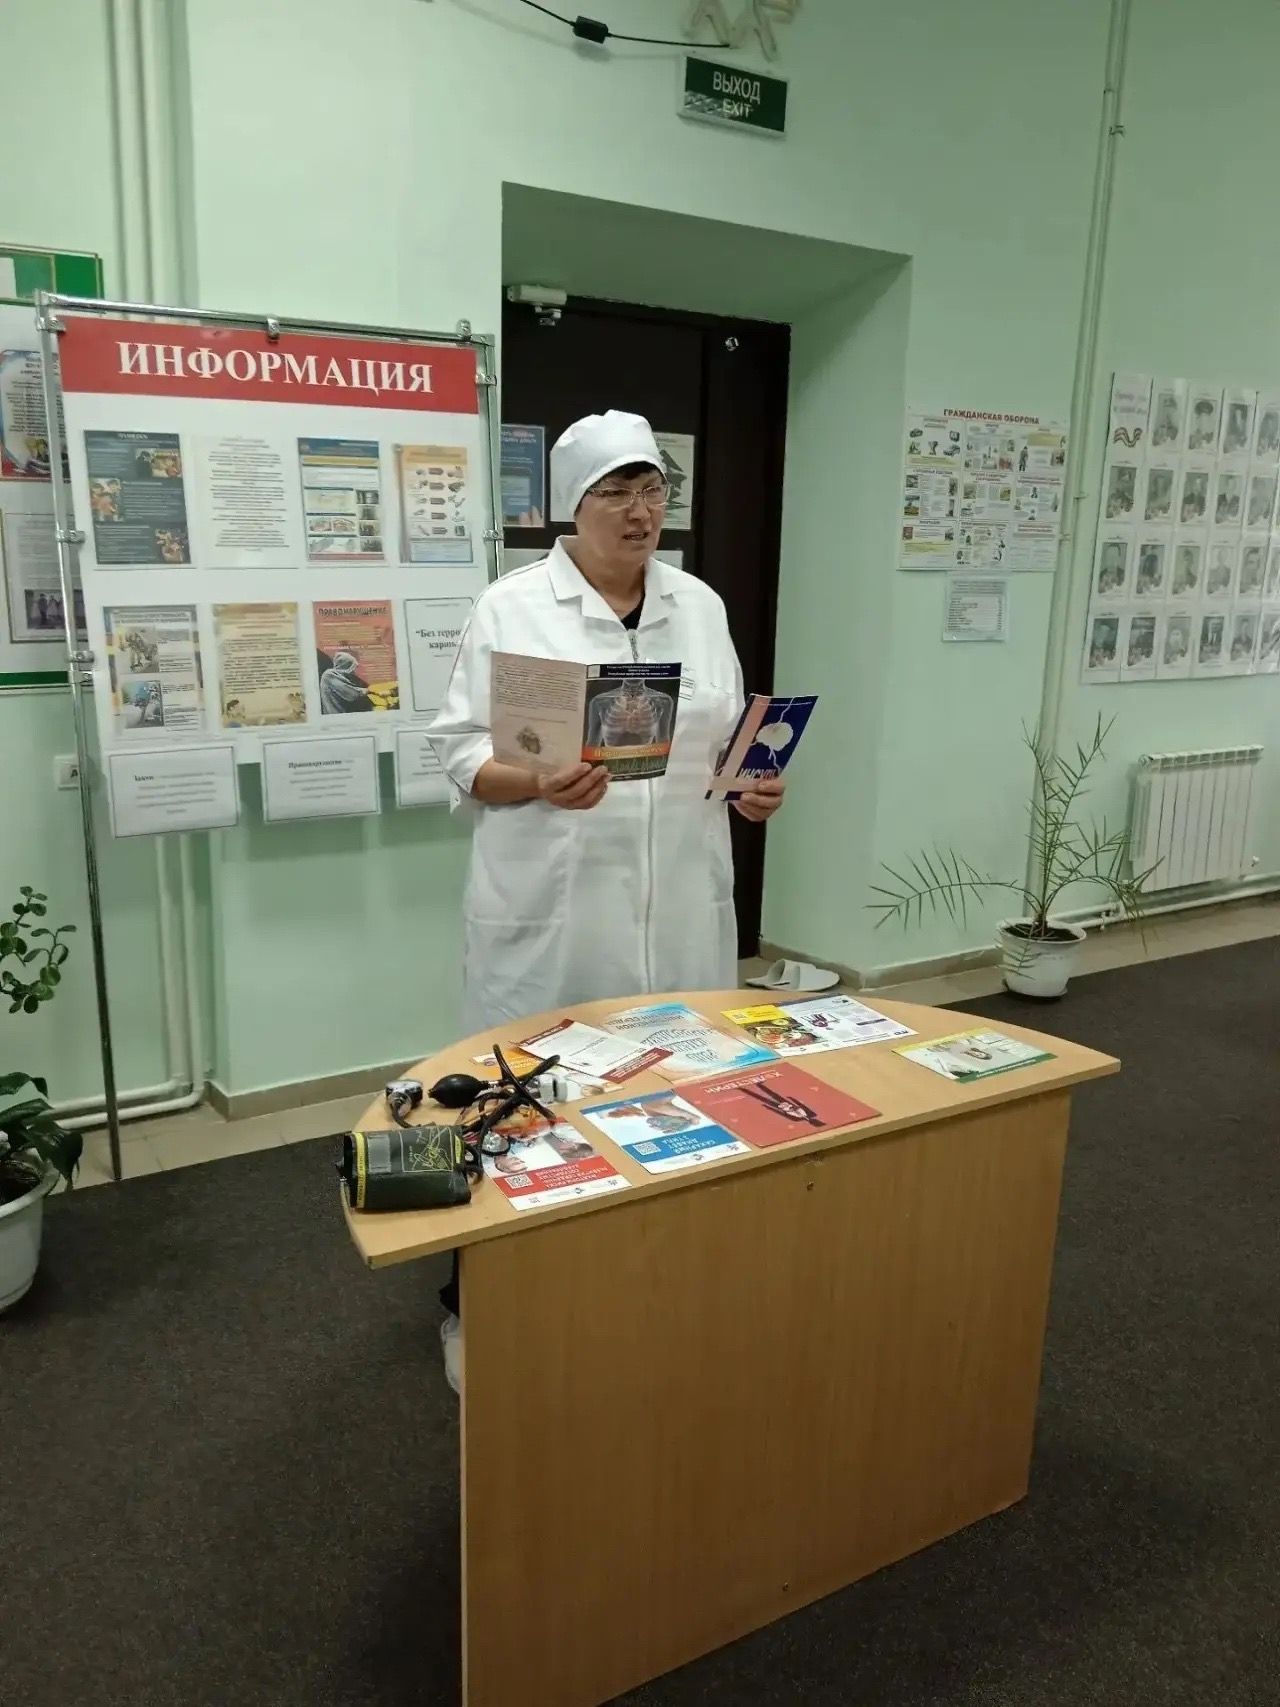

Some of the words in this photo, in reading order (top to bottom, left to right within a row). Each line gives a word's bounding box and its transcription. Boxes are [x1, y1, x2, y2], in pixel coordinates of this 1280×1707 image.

[713, 71, 760, 105] ВЫХОД
[722, 98, 752, 118] EXIT
[114, 341, 434, 396] ИНФОРМАЦИЯ
[943, 408, 1003, 421] ГРАЖДАНСКАЯ
[1003, 414, 1040, 424] ОБОРОНА
